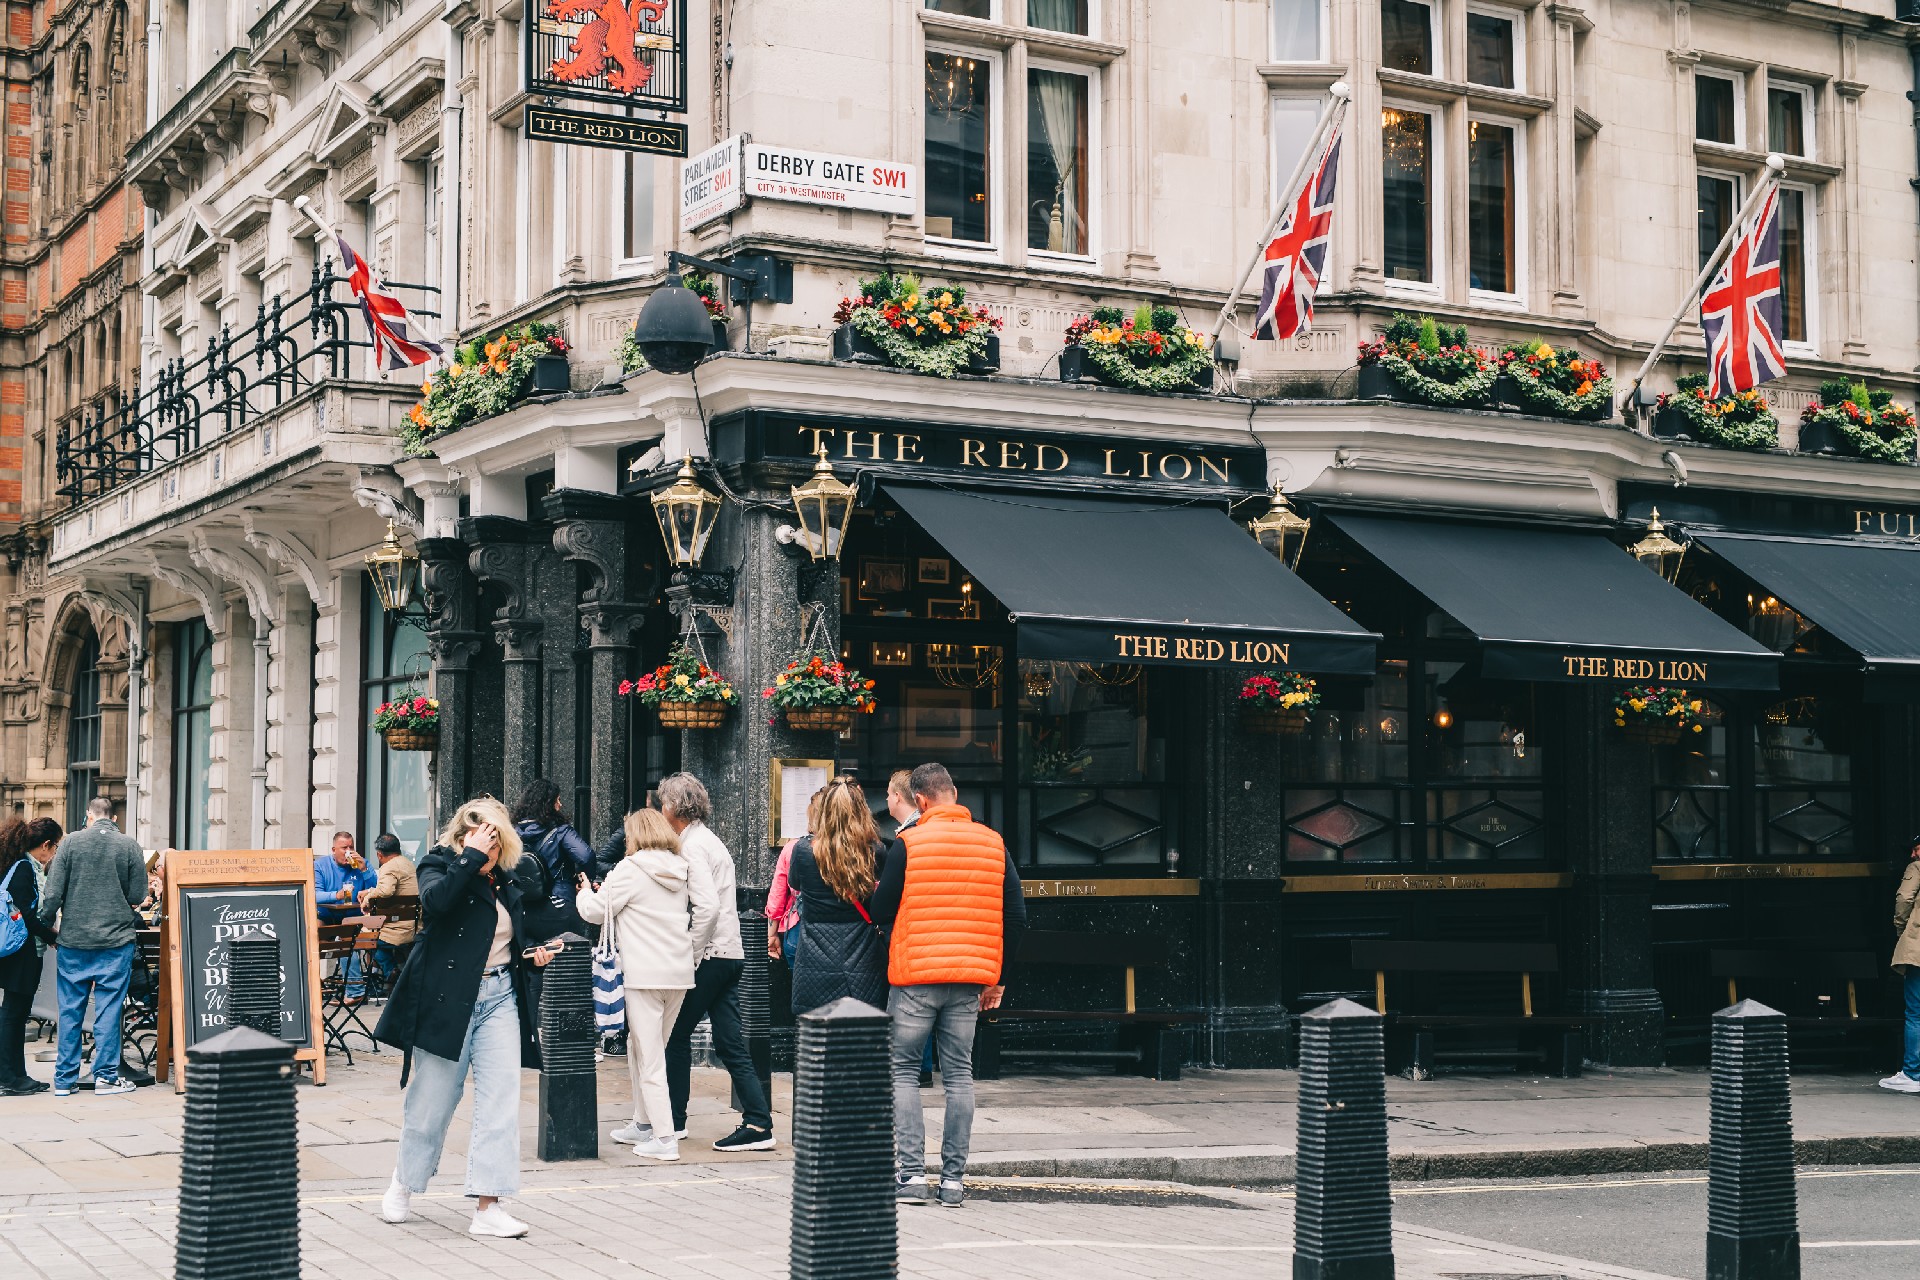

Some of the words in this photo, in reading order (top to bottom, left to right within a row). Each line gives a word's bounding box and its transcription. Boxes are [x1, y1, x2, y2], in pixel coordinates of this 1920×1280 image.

[536, 117, 579, 134] THE
[584, 123, 623, 138] RED
[629, 129, 677, 146] LION
[684, 144, 732, 185] PARLIAMENT
[758, 152, 815, 177] DERBY
[823, 161, 865, 184] GATE
[873, 167, 906, 189] SW1
[684, 178, 713, 207] STREET
[714, 168, 732, 192] SW1
[758, 182, 775, 193] CITY
[779, 185, 788, 194] OF
[790, 186, 846, 202] WESTMINSTER
[798, 425, 925, 463] THE
[959, 438, 1069, 472] RED
[1101, 448, 1233, 483] LION
[1114, 634, 1169, 659] THE
[1174, 638, 1225, 661] RED
[1229, 640, 1290, 665] LION
[1563, 655, 1609, 678] THE
[1613, 658, 1654, 680] RED
[1658, 660, 1708, 682] LION
[1763, 748, 1795, 761] MENU
[1480, 824, 1491, 832] RED
[1488, 817, 1499, 825] THE
[189, 858, 220, 866] FULLER
[1038, 882, 1049, 896] &
[1054, 881, 1097, 896] TURNER
[213, 904, 270, 924] Famous
